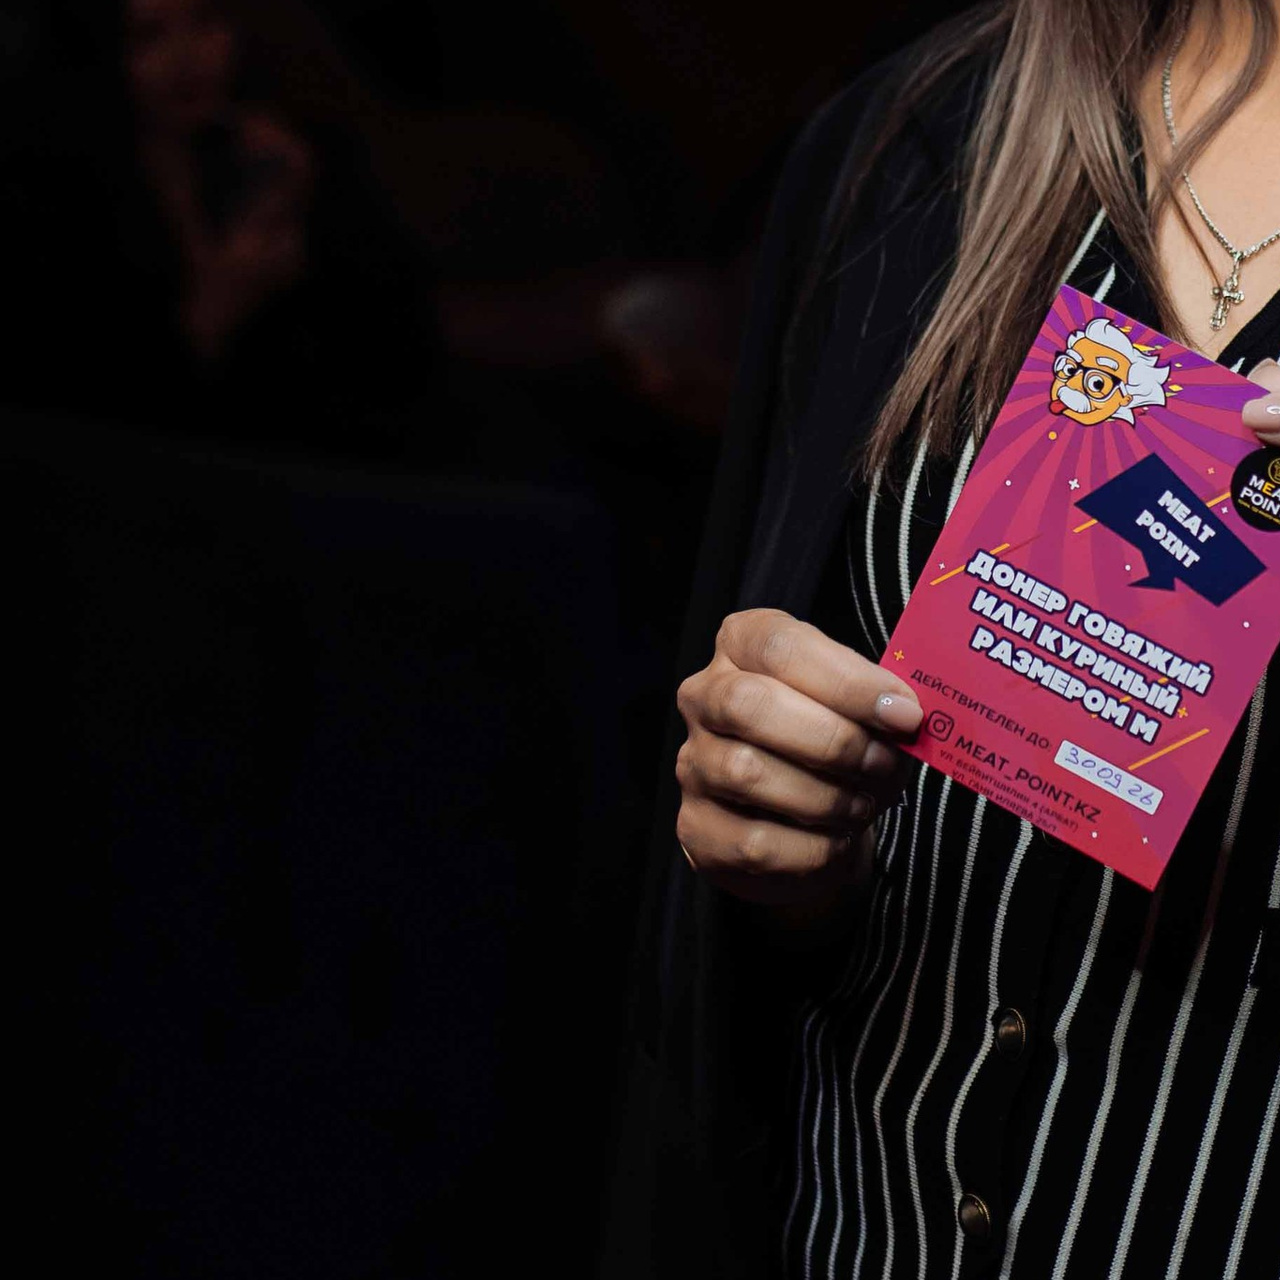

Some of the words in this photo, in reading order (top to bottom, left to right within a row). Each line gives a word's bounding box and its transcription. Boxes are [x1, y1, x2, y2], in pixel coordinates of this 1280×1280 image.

[1135, 509, 1200, 568] POINT
[1157, 489, 1216, 543] MEAT
[966, 549, 1068, 613] ДОНЕР
[1066, 602, 1212, 695] ГОВЯЖИЙ
[971, 588, 1039, 640] ИЛИ
[1036, 623, 1180, 717] КУРИНЫЙ
[911, 669, 1026, 737] ДЕЙСТВИТЕЛЕН
[970, 626, 1131, 728] РАЗМЕРОМ
[1129, 712, 1160, 744] М
[955, 735, 1103, 824] MEAT_POINT.KZ
